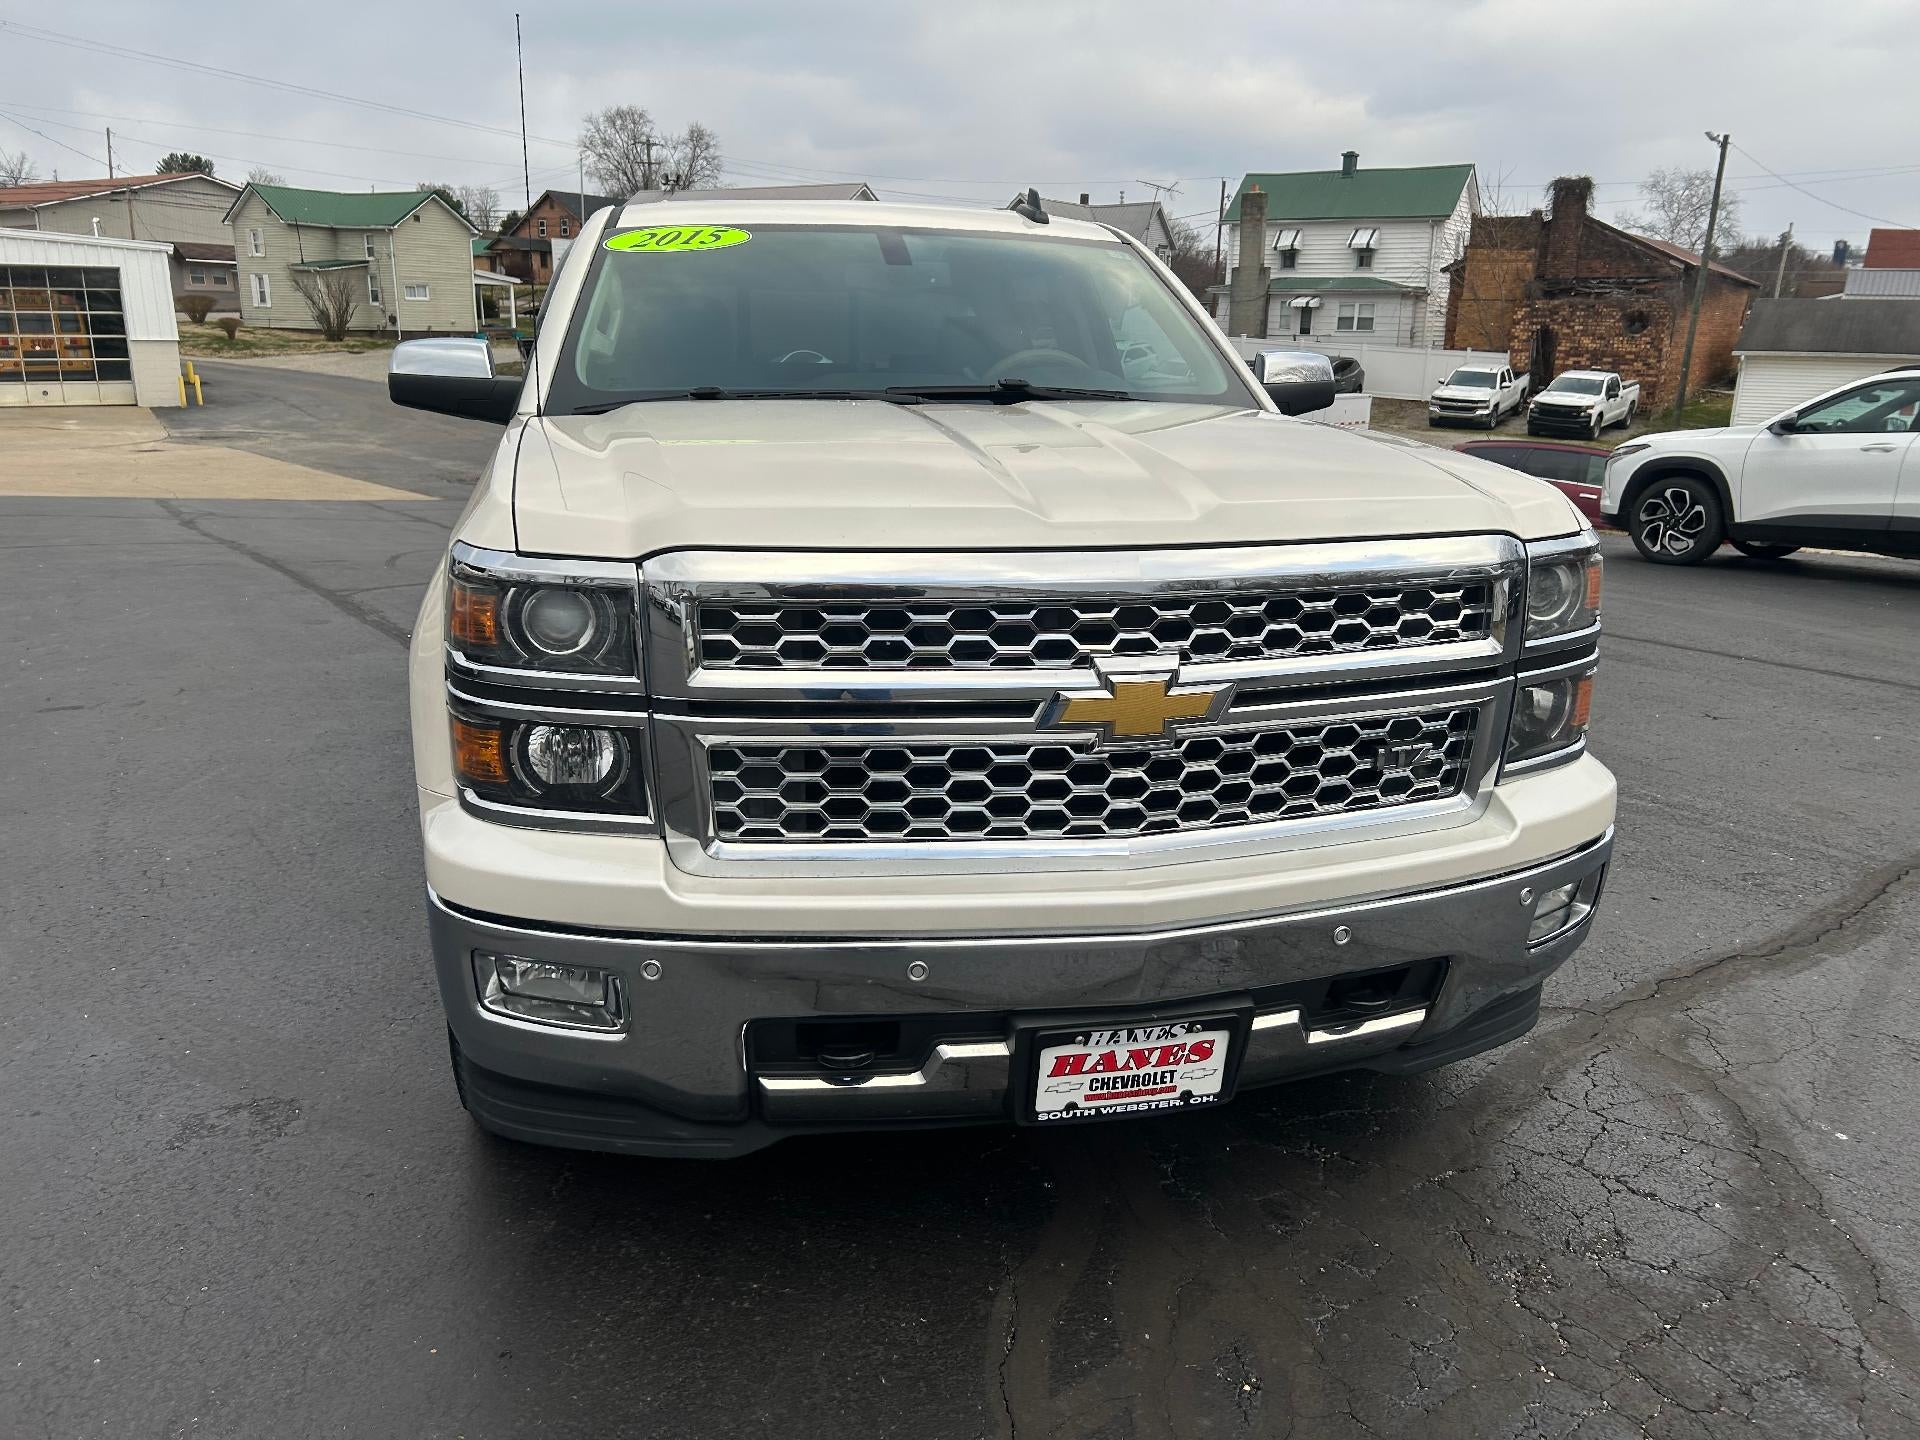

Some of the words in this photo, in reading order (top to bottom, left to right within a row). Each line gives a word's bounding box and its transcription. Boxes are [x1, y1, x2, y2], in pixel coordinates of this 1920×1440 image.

[628, 229, 728, 248] 2015
[1087, 1022, 1190, 1047] HANES
[1047, 1039, 1216, 1078] HANES
[1089, 1069, 1178, 1092] CHEVROLET
[1037, 1109, 1096, 1121] SOUTH
[1189, 1095, 1218, 1105] OH.
